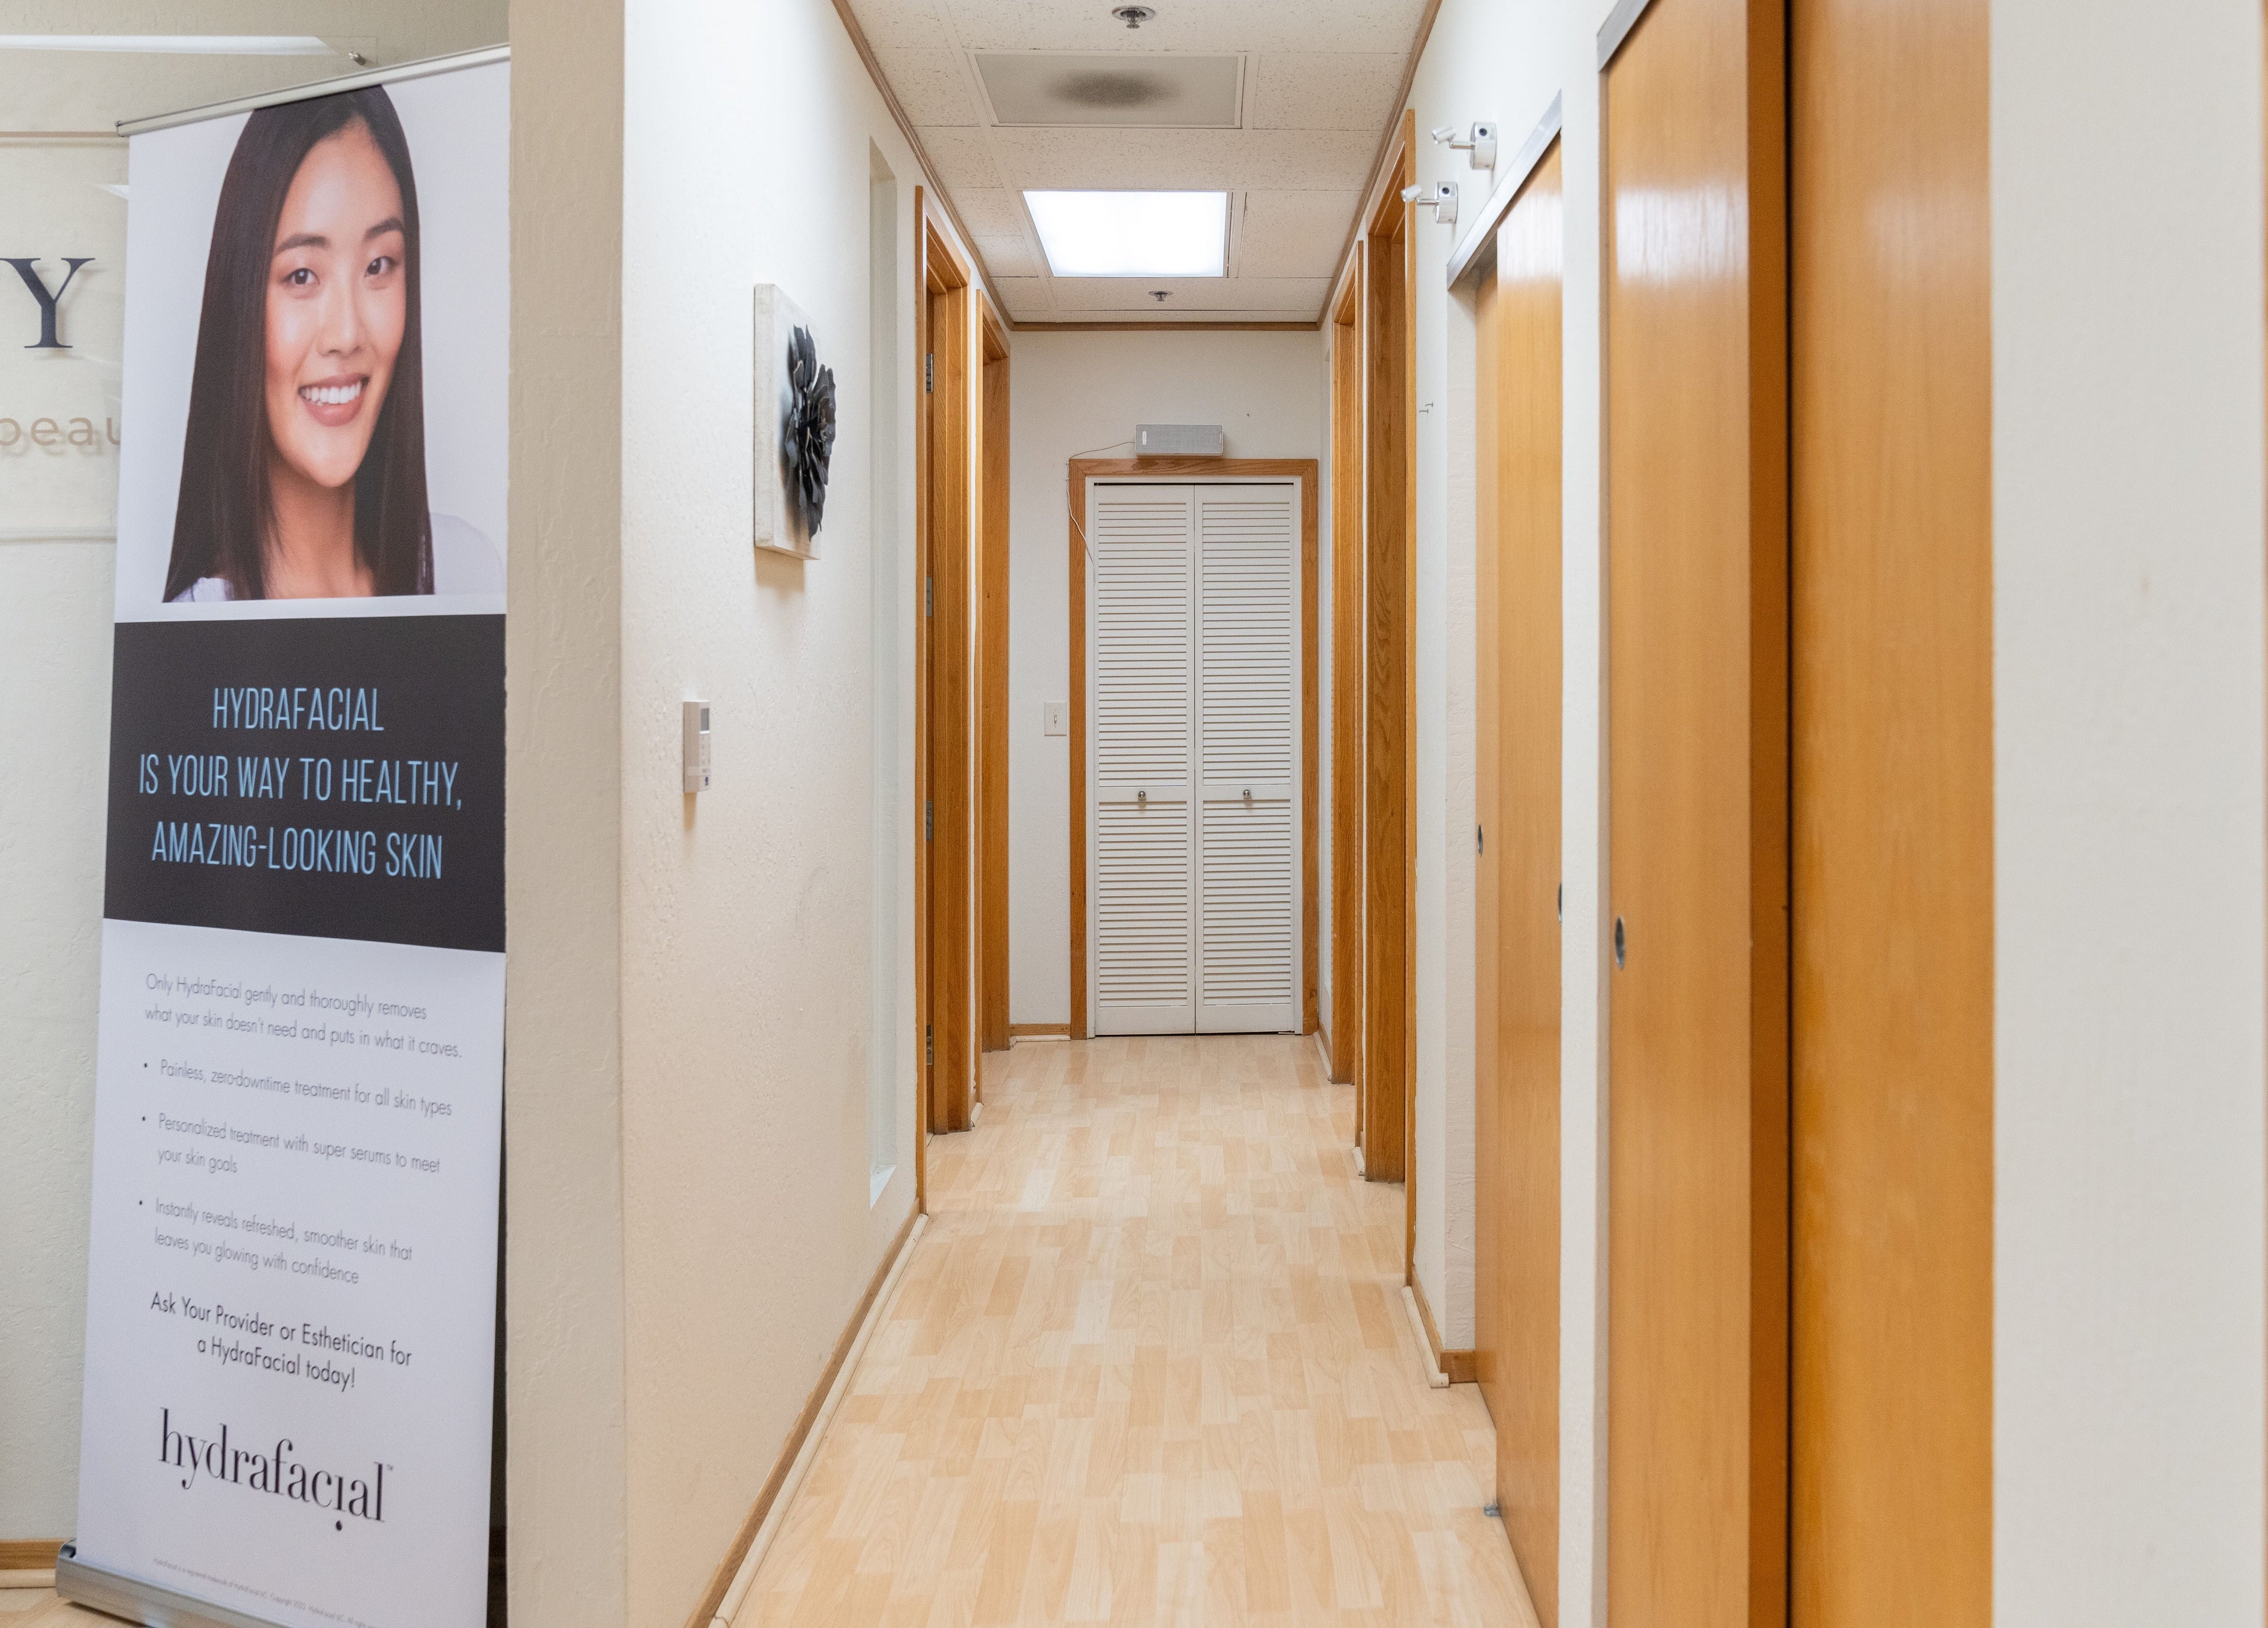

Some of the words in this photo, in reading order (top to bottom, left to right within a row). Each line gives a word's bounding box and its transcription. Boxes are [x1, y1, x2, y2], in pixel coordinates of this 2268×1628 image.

[0, 258, 95, 348] Y
[214, 688, 384, 731] HYDRAFACIAL
[140, 754, 159, 794] IS
[168, 755, 228, 796] YOUR
[238, 757, 289, 799] WAY
[299, 758, 331, 800] TO
[342, 759, 461, 810] HEALTHY,
[152, 821, 376, 874] AMAZING-LOOKING
[386, 832, 442, 879] SKIN
[146, 973, 173, 996] Only
[177, 976, 242, 999] HydraFacial
[245, 985, 278, 1008] gently
[282, 988, 305, 1006] and
[309, 989, 374, 1018] thoroughly
[379, 1003, 426, 1020] removes
[145, 1004, 172, 1022] what
[175, 1013, 200, 1027] your
[203, 1010, 222, 1027] skin
[226, 1012, 264, 1033] doesn't
[268, 1020, 297, 1037] need
[302, 1023, 325, 1041] and
[330, 1030, 354, 1047] puts
[359, 1030, 370, 1046] in
[375, 1030, 404, 1050] what
[408, 1036, 415, 1051] it
[419, 1041, 462, 1057] craves.
[161, 1059, 206, 1083] Painless,
[211, 1069, 291, 1093] zero-downtime
[295, 1081, 350, 1100] treatment
[354, 1083, 371, 1103] for
[375, 1087, 389, 1106] all
[394, 1090, 416, 1109] skin
[421, 1098, 452, 1118] types
[158, 1150, 182, 1164] your
[185, 1148, 205, 1166] skin
[209, 1155, 237, 1174] goals
[159, 1112, 226, 1139] Personalized
[230, 1128, 279, 1148] treatment
[284, 1134, 308, 1152] with
[314, 1142, 347, 1160] super
[351, 1148, 391, 1165] serums
[395, 1152, 407, 1167] to
[411, 1158, 440, 1173] meet
[155, 1227, 189, 1250] leaves
[193, 1242, 211, 1256] you
[215, 1241, 259, 1271] glowing
[263, 1252, 287, 1270] with
[292, 1258, 359, 1284] confidence
[156, 1197, 198, 1225] Instantly
[202, 1211, 238, 1229] reveals
[242, 1215, 298, 1242] refreshed,
[304, 1230, 359, 1250] smoother
[363, 1235, 385, 1255] skin
[390, 1239, 412, 1261] that
[151, 1292, 175, 1314] Ask
[182, 1297, 211, 1321] Your
[216, 1305, 274, 1336] Provider
[280, 1326, 296, 1340] or
[302, 1323, 383, 1360] Esthetician
[390, 1340, 412, 1366] for
[197, 1340, 206, 1353] a
[212, 1337, 300, 1375] HydraFacial
[307, 1360, 354, 1392] today!
[159, 1408, 385, 1531] hydrafacial
